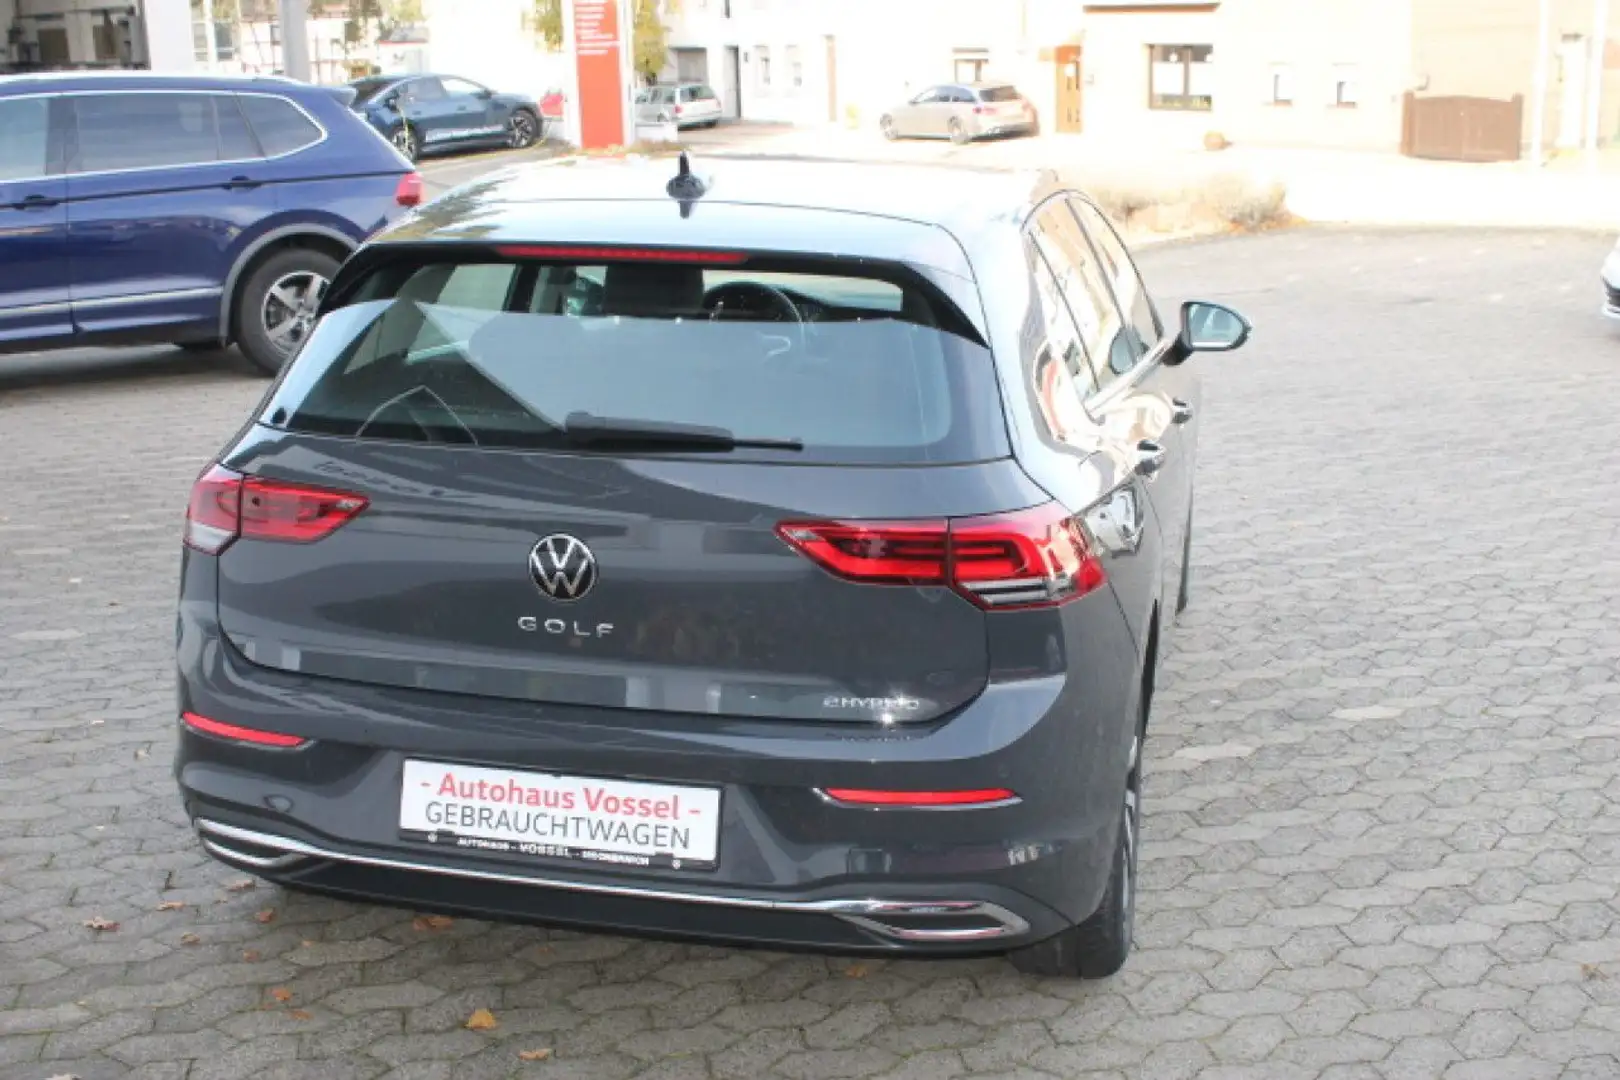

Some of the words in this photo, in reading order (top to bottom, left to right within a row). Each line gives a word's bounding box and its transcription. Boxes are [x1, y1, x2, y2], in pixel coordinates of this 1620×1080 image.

[517, 616, 614, 638] GOLF
[437, 773, 575, 809] Autohaus
[583, 787, 679, 820] Vossel
[425, 801, 690, 849] GEBRAUCHTWAGEN
